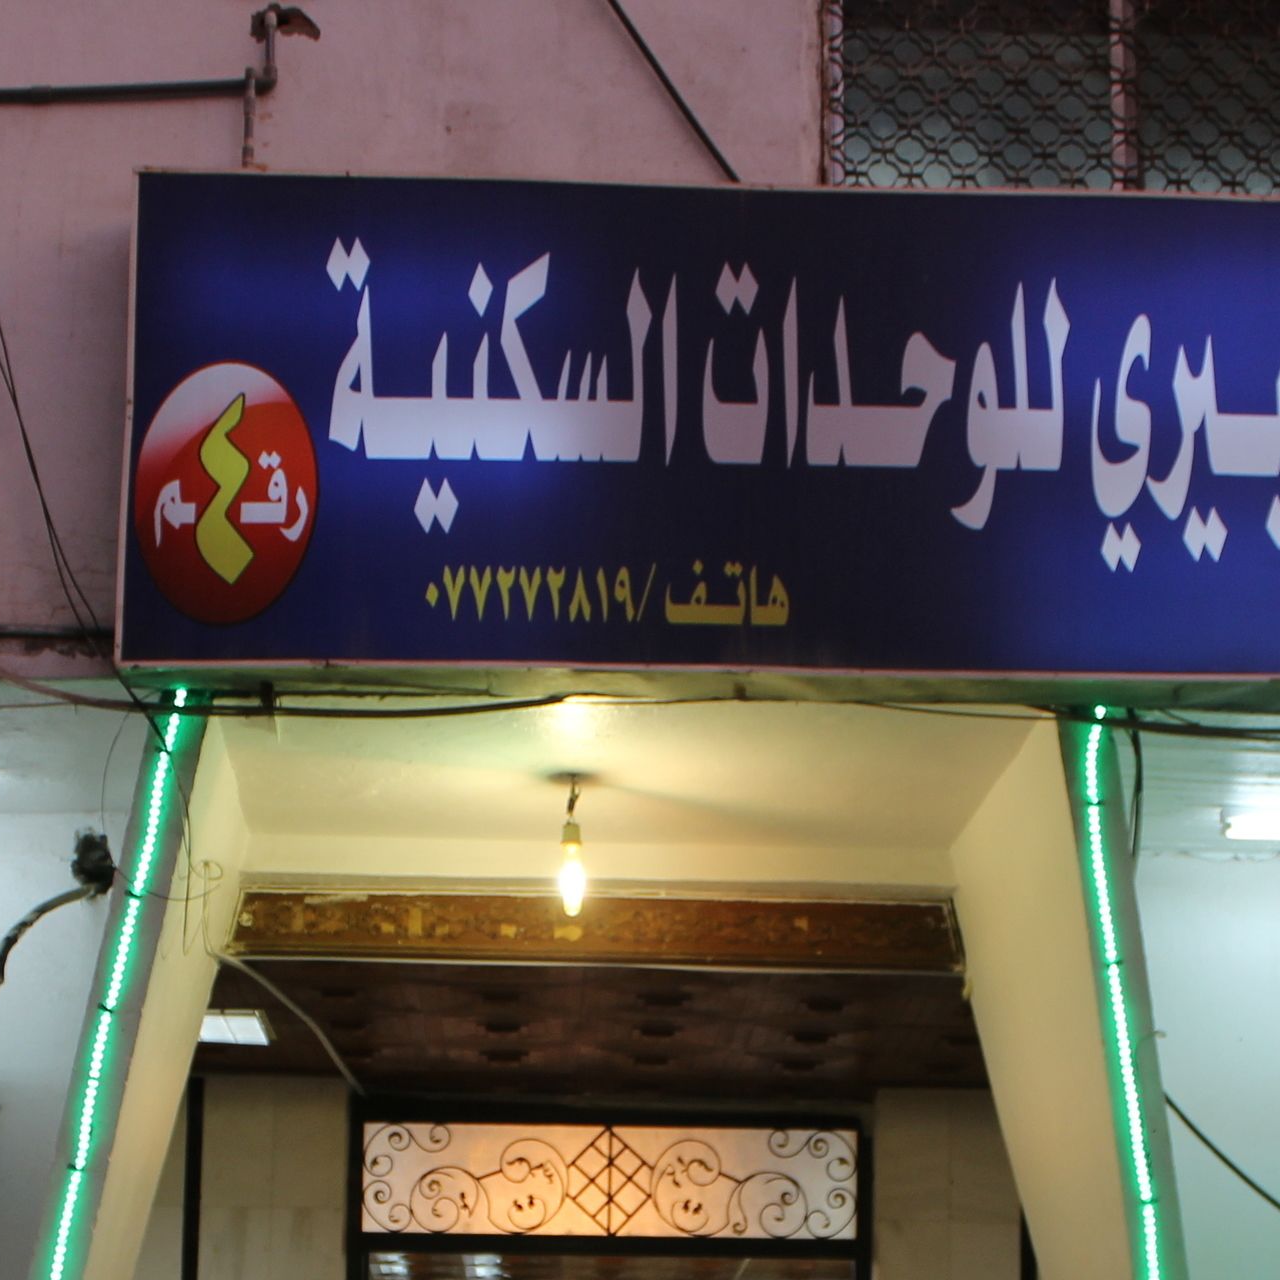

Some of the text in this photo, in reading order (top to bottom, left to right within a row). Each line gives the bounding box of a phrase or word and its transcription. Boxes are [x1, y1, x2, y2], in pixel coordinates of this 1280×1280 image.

[153, 450, 309, 548] رقم
[325, 236, 678, 535] السكنية
[701, 260, 1071, 531] للوحدات
